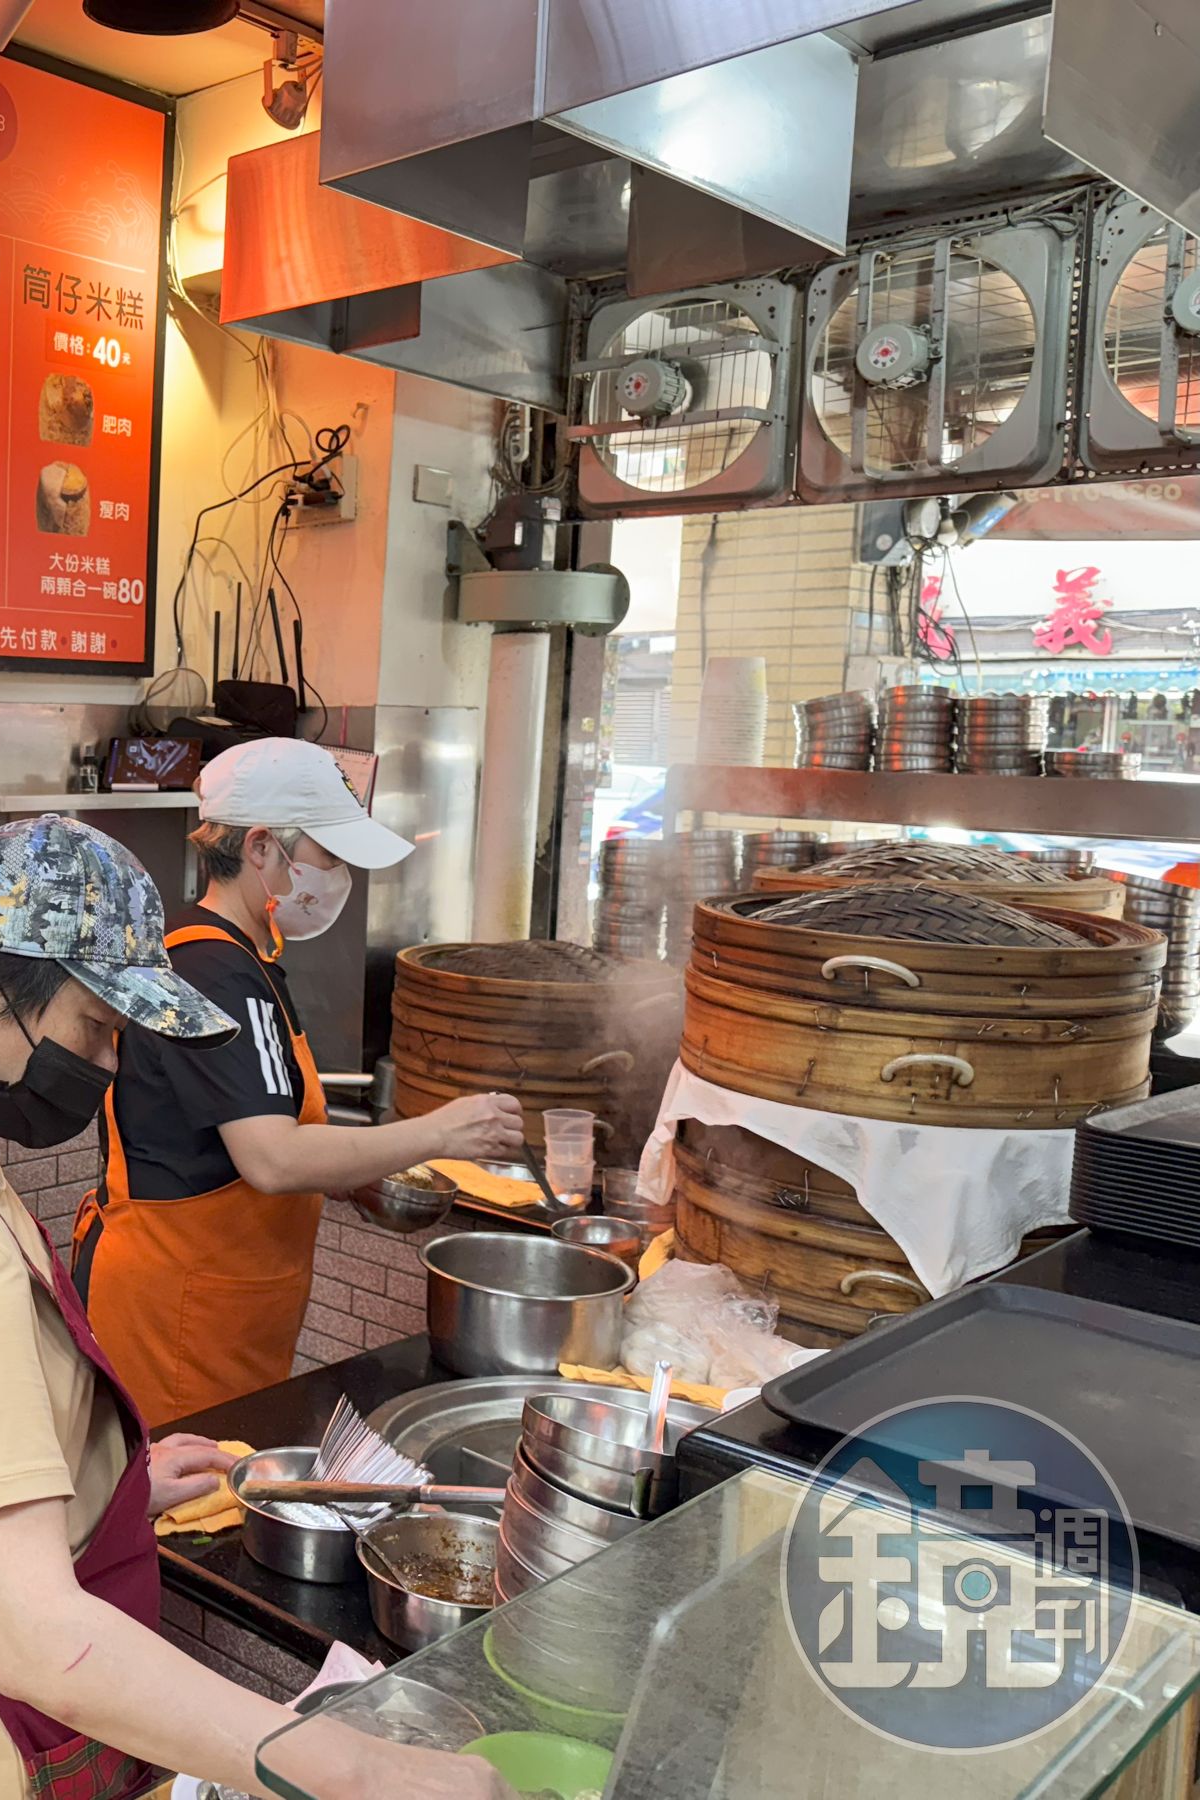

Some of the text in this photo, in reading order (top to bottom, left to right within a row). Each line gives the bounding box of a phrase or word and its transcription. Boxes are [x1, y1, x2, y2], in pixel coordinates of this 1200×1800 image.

[21, 263, 145, 331] 筒仔米糕
[101, 413, 133, 438] 肥肉
[48, 552, 111, 576] 大份米糕
[0, 625, 58, 652] 先付款
[70, 630, 106, 655] 謝謝
